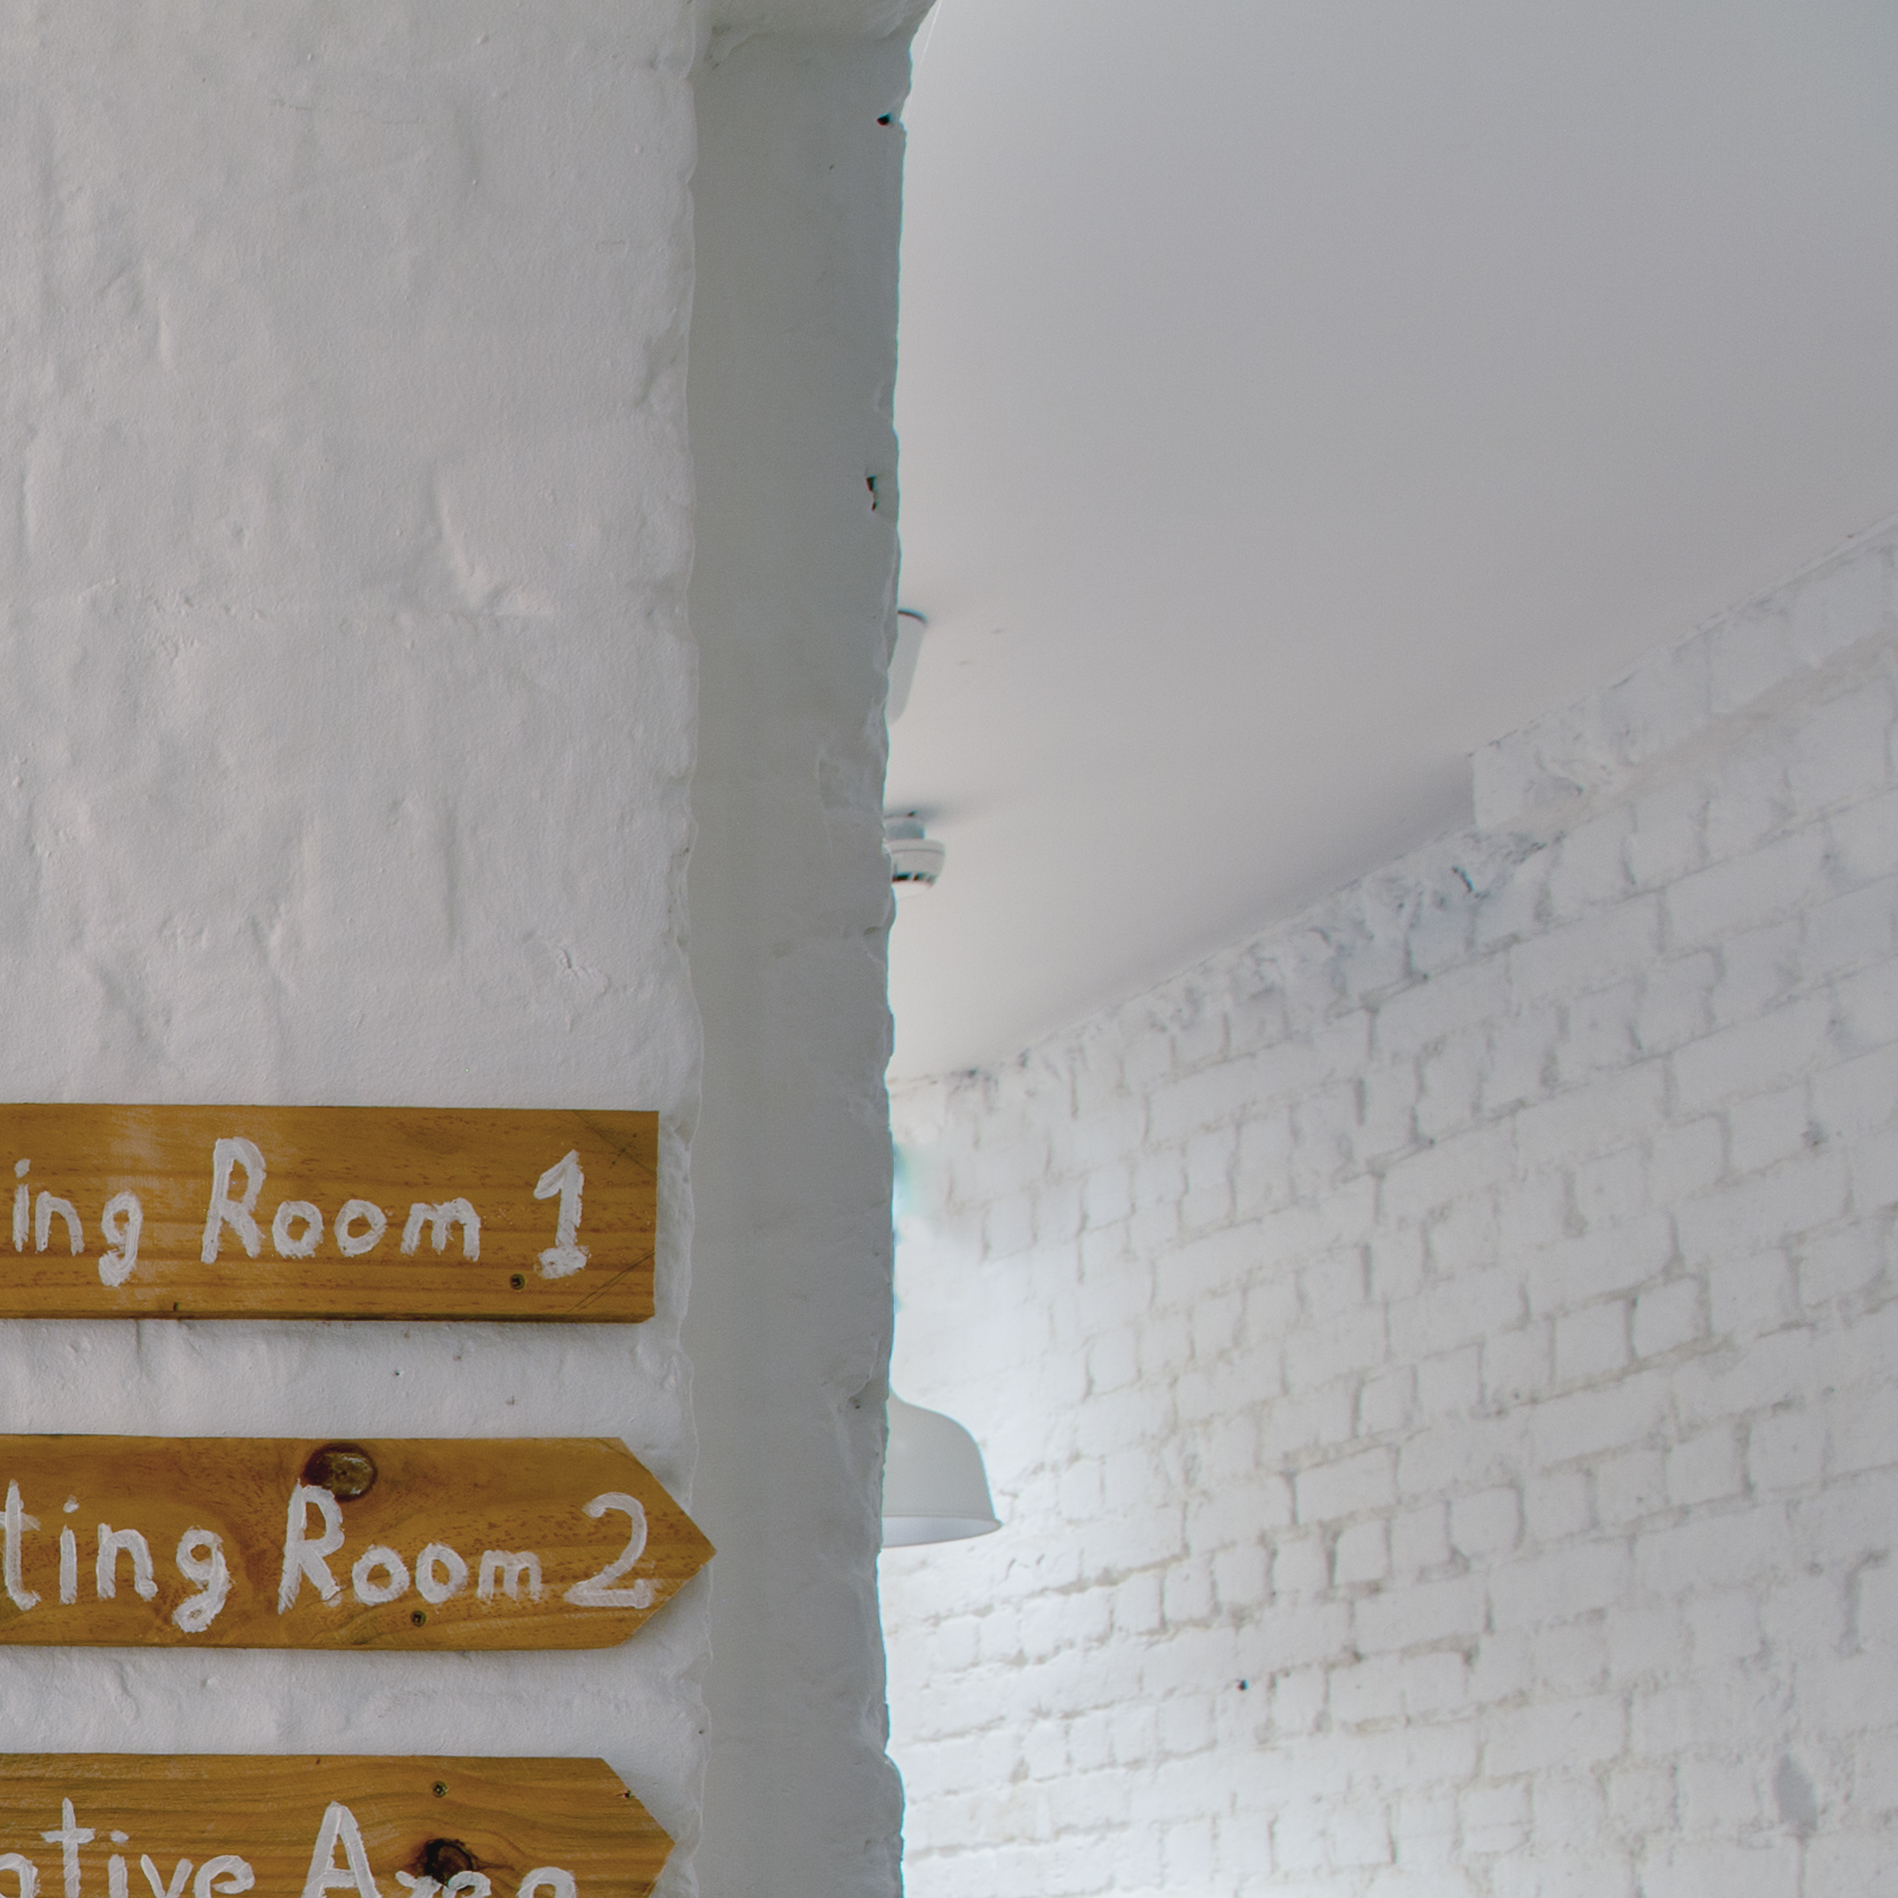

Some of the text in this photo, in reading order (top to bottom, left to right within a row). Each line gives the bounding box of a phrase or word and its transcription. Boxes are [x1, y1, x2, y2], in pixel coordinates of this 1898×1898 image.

[200, 1136, 482, 1266] Room
[531, 1148, 590, 1280] 1
[277, 1481, 544, 1615] Room
[563, 1491, 662, 1610] 2
